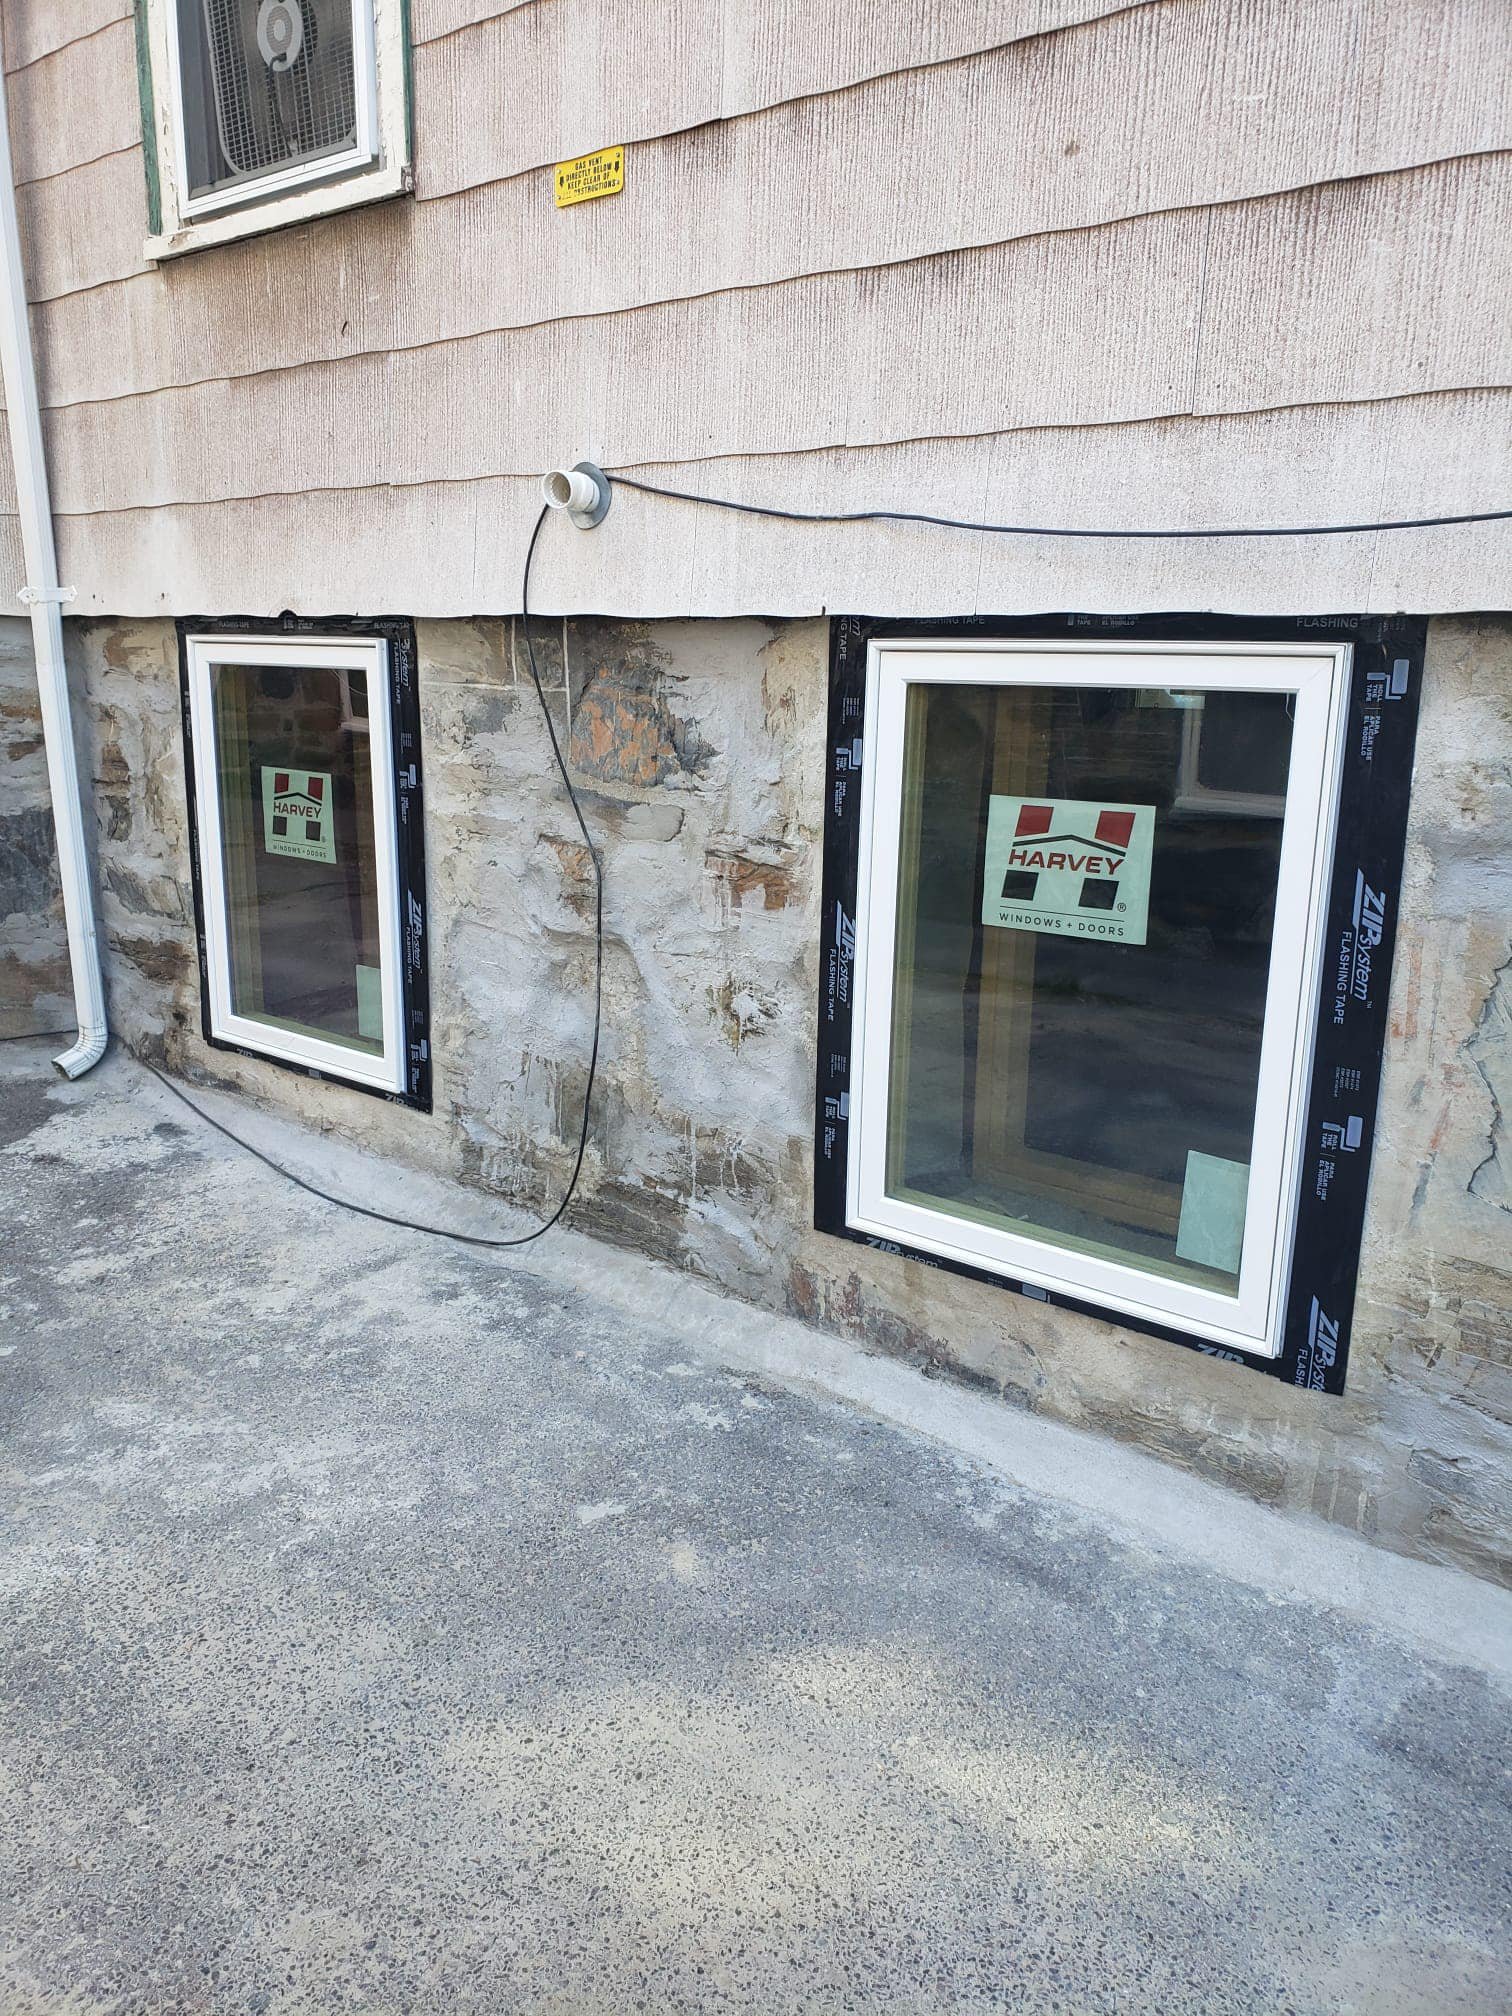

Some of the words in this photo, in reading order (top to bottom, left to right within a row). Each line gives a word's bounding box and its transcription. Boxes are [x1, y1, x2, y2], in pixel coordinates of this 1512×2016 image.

[566, 169, 590, 181] DIRECTLY
[594, 162, 612, 174] BELOW
[575, 160, 586, 170] GAS
[589, 156, 602, 166] VENT
[568, 180, 581, 190] KEEP
[584, 175, 600, 186] CLEAR
[1296, 617, 1358, 628] FLASHING
[274, 802, 322, 818] HARVEY
[1008, 849, 1124, 875] HARVEY
[1000, 913, 1061, 928] WINDOWS
[1079, 923, 1124, 936] DOORS
[828, 948, 836, 994] FLASHING
[1337, 931, 1352, 991] FLASHING
[1334, 994, 1346, 1025] TAPE
